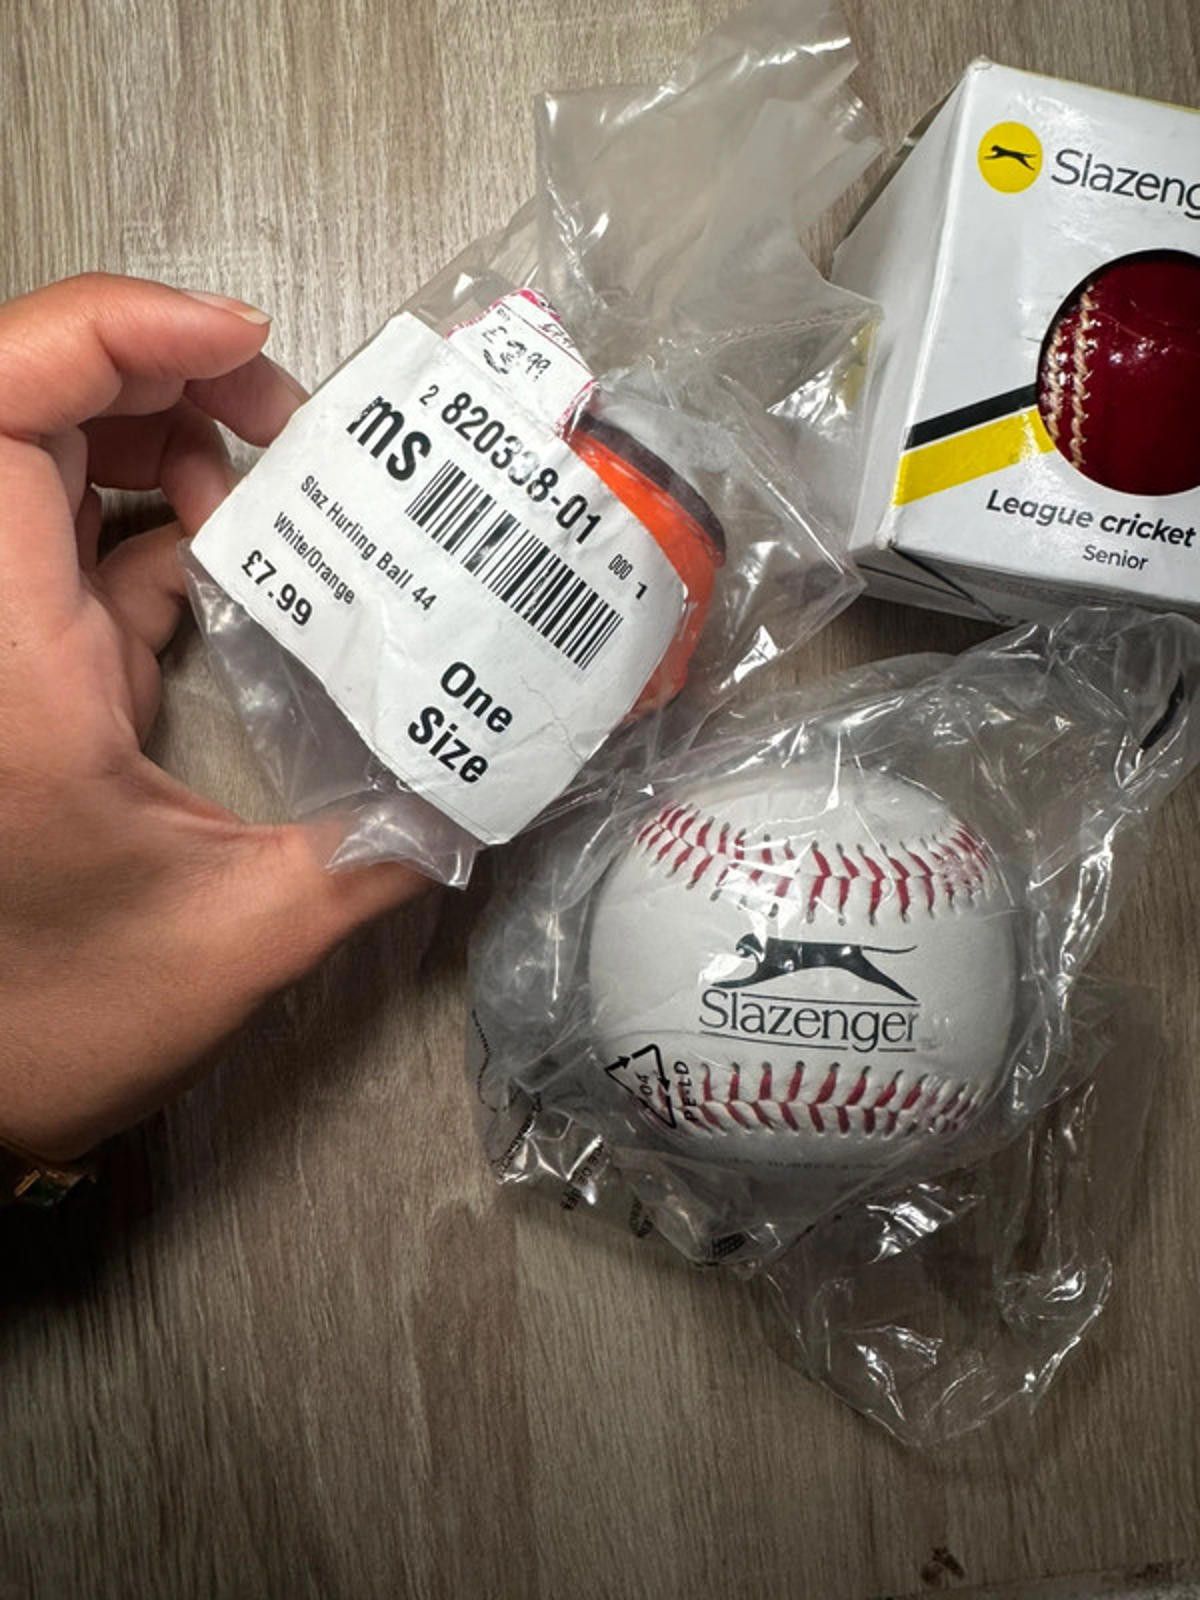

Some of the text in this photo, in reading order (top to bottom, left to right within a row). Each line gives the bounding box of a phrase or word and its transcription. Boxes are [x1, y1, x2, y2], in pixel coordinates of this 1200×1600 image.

[419, 384, 440, 406] 2
[301, 475, 438, 611] Slaz Hurling Ball 44
[986, 489, 1197, 547] League cricket
[241, 549, 313, 626] £7.99
[273, 511, 355, 604] White/Orange
[1082, 544, 1149, 570] Senior
[440, 661, 513, 733] One
[408, 706, 489, 783] Size
[699, 988, 919, 1053] Slazenger
